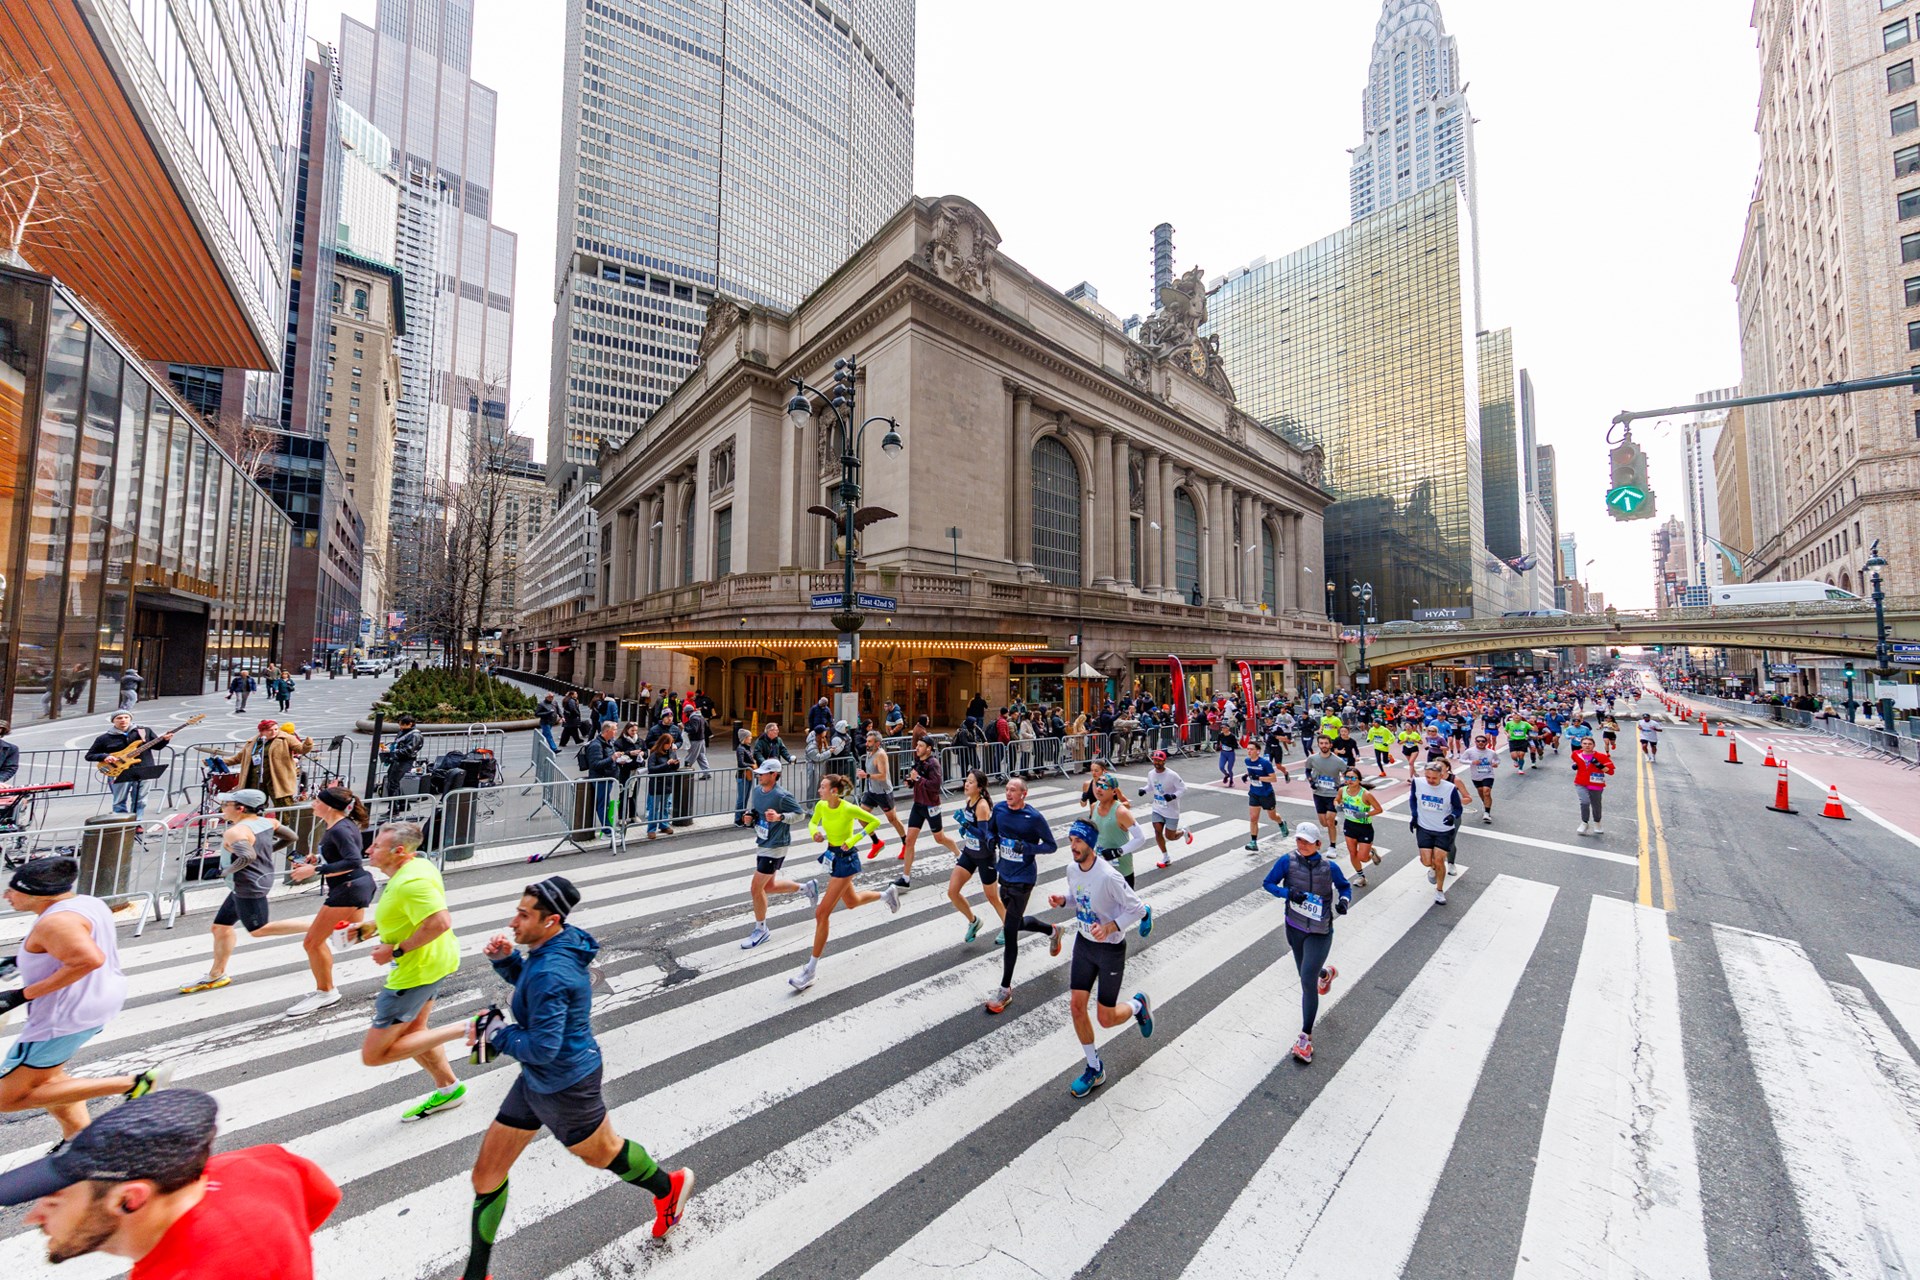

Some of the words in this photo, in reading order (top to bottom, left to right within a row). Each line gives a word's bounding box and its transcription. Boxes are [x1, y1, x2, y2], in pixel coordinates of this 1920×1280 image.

[860, 596, 873, 606] East
[874, 599, 887, 608] 42nd
[888, 601, 895, 609] St
[1425, 609, 1457, 618] HYATT
[1411, 646, 1446, 657] GRAND
[1453, 640, 1504, 650] CENTRAL
[1514, 635, 1579, 645] TERMINAL
[1661, 633, 1745, 642] PERSHING
[1757, 635, 1830, 646] SQUARE
